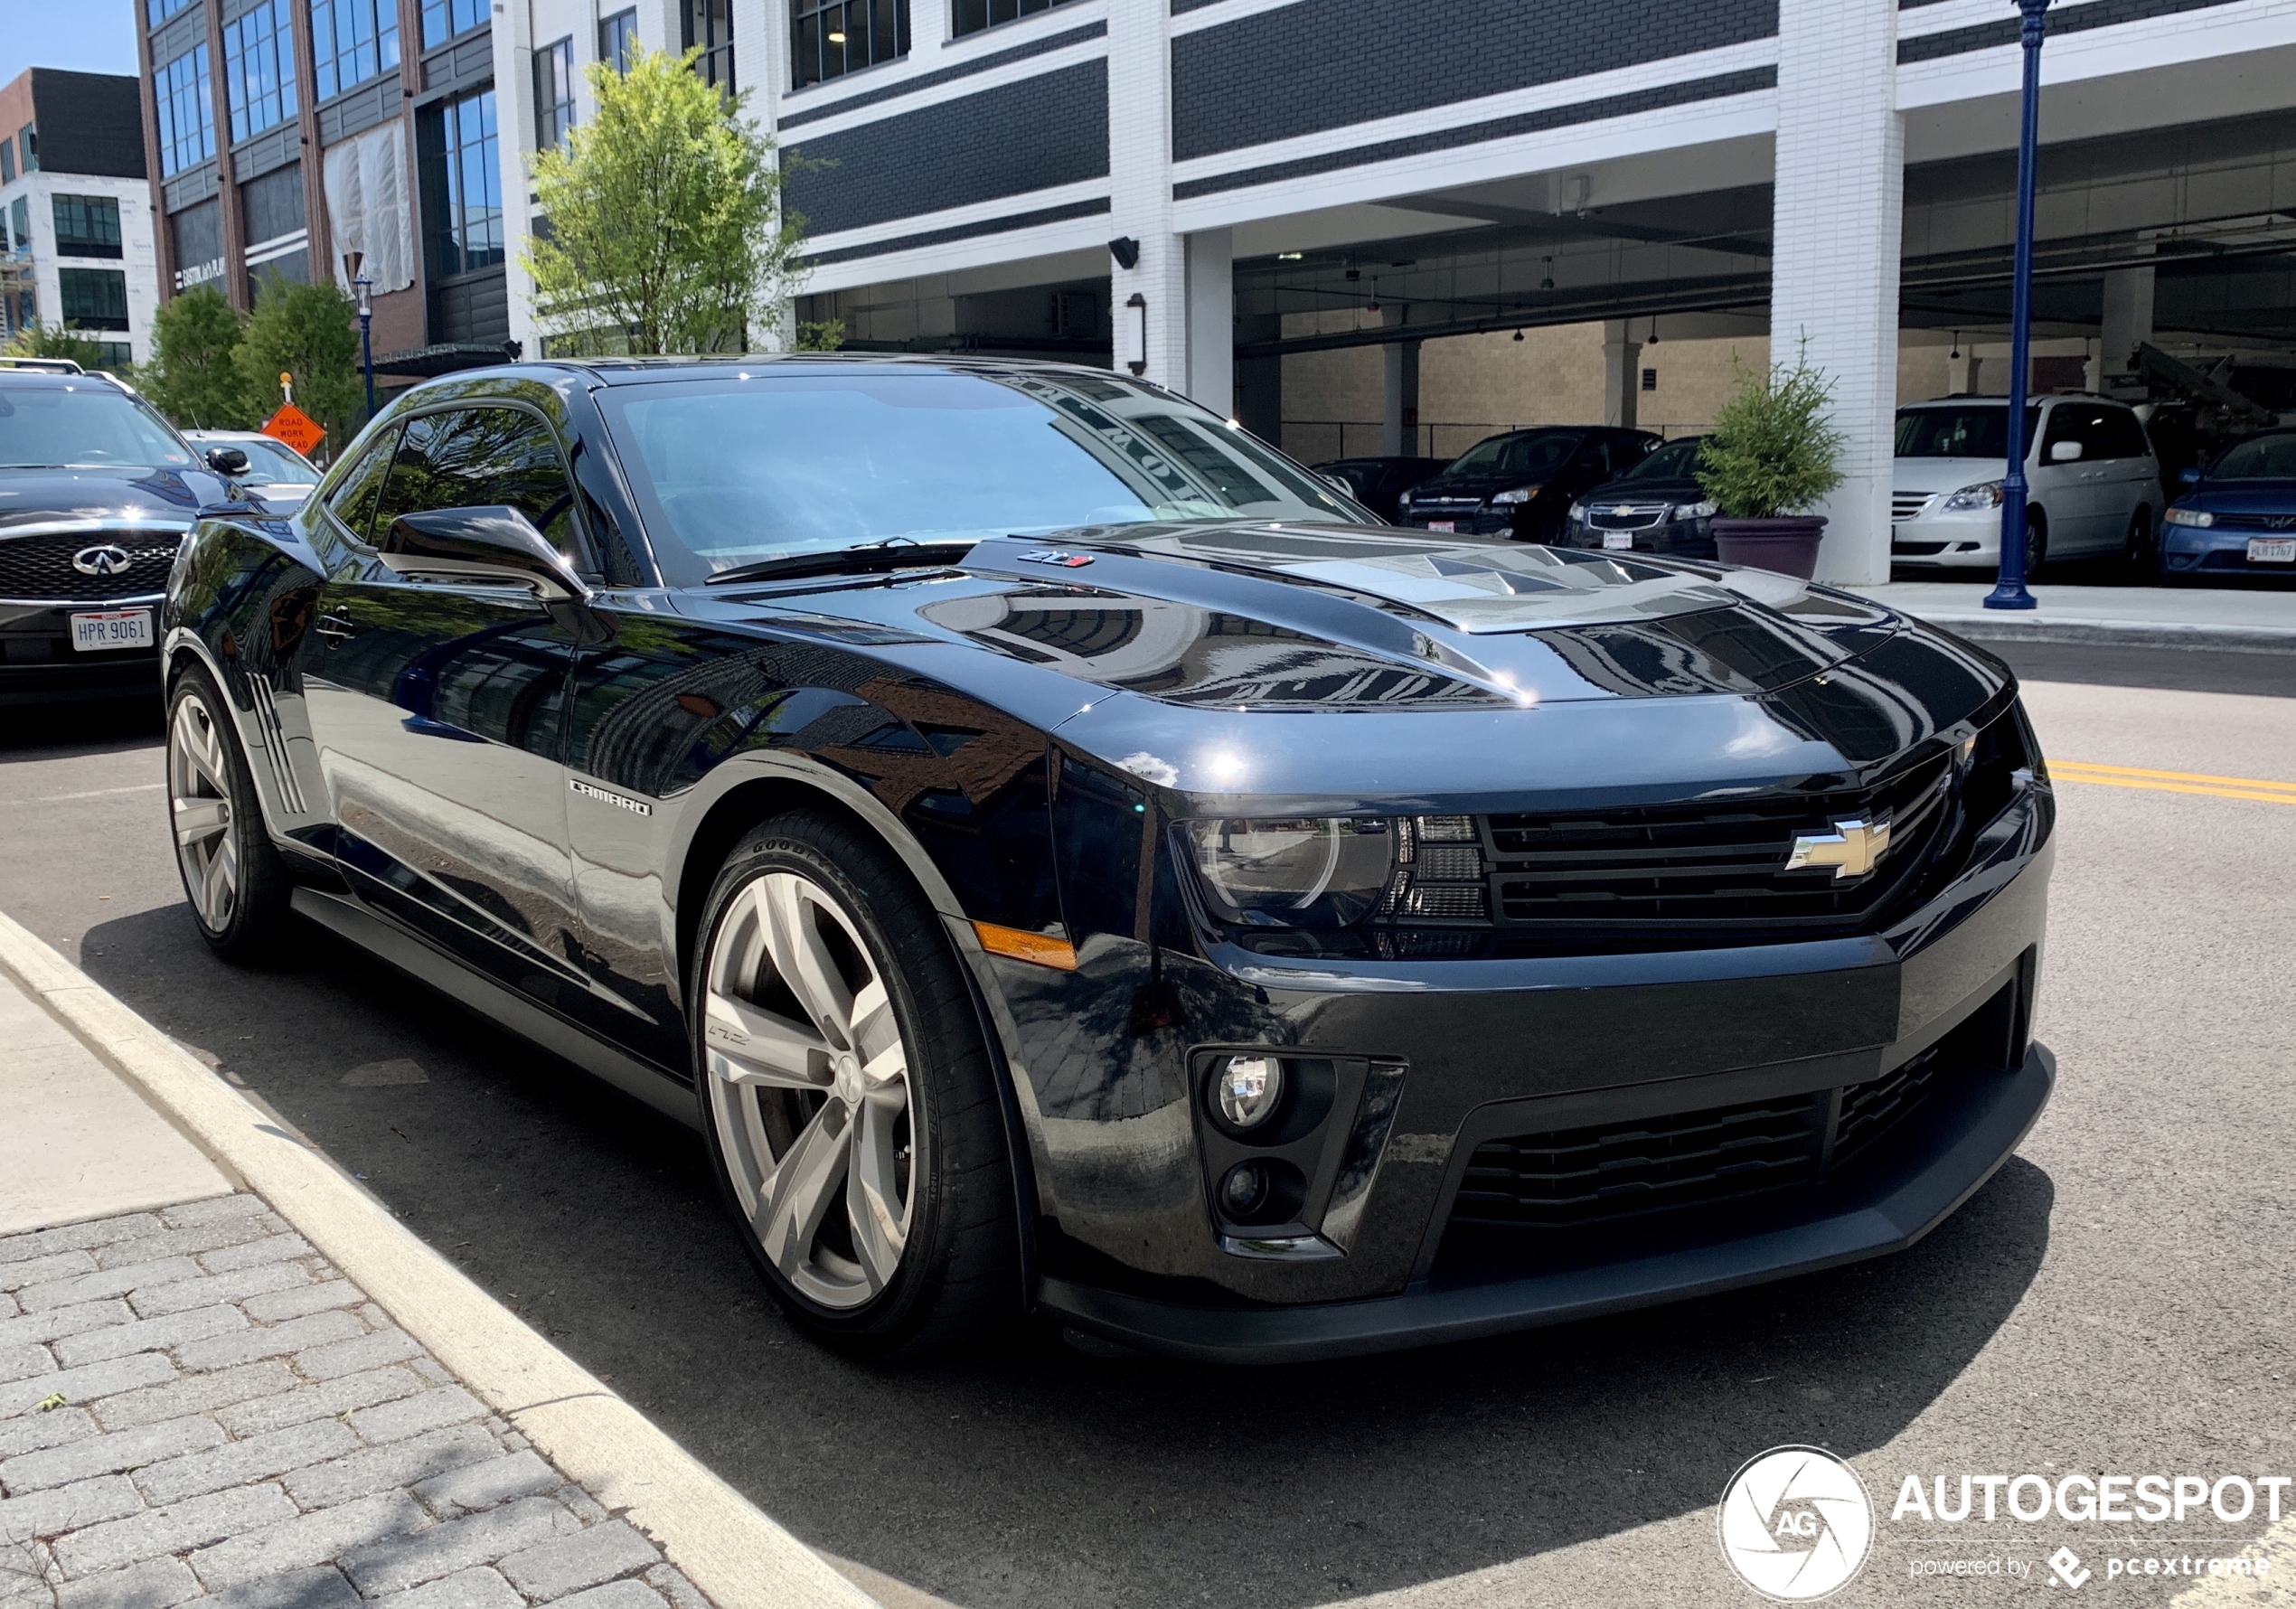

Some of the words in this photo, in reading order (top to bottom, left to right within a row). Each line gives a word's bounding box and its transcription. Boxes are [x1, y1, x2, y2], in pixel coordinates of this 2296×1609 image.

[278, 418, 303, 427] ROAD
[280, 429, 305, 438] WORK
[288, 440, 308, 448] EAD
[1016, 550, 1096, 569] ZL1
[78, 622, 106, 642] HPR
[110, 620, 145, 639] 9061
[569, 778, 653, 816] CAMARO
